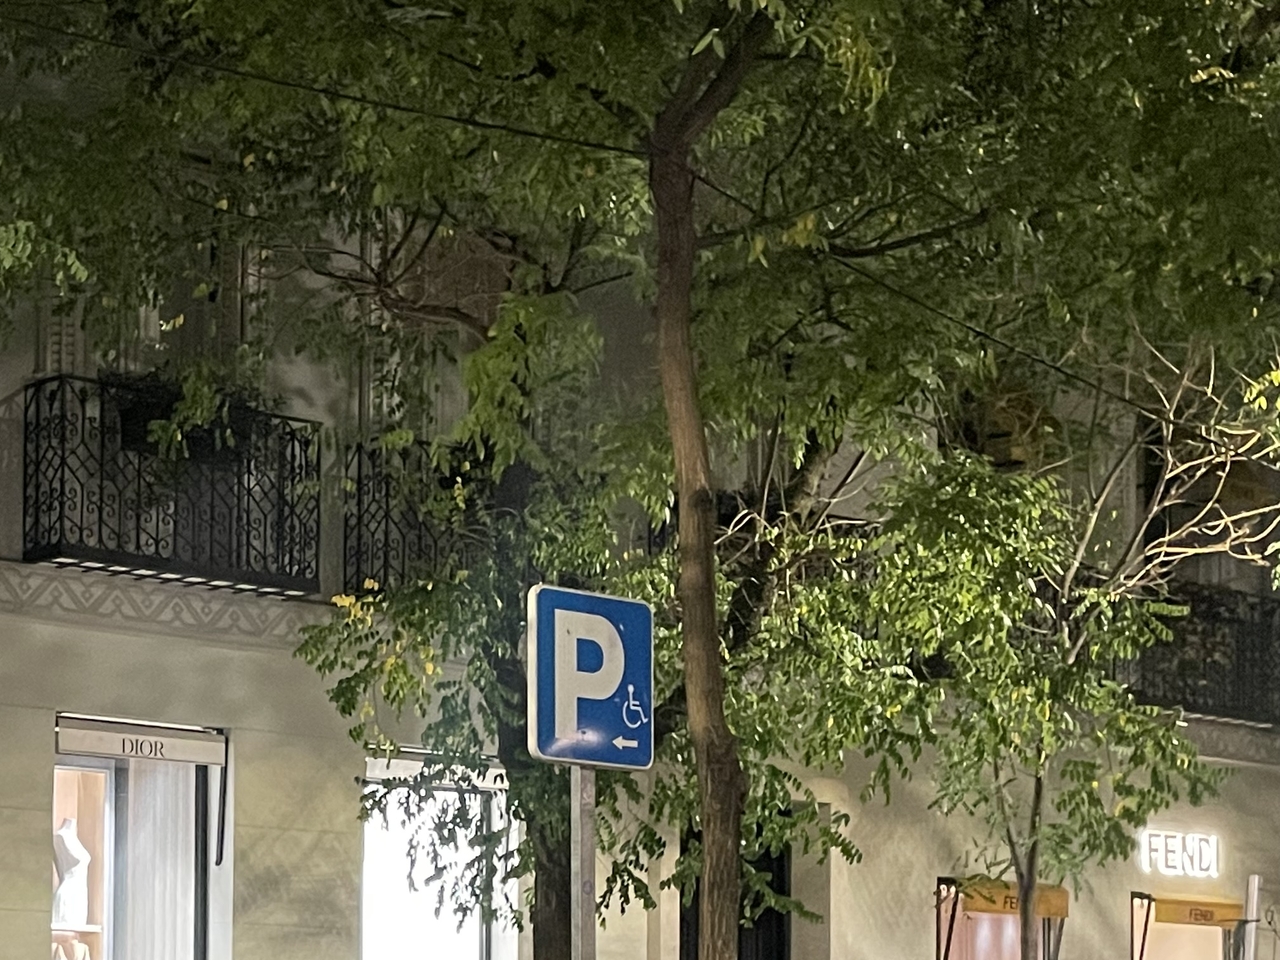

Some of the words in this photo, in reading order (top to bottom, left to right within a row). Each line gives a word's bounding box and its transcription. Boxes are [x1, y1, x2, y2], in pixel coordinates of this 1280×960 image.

[554, 608, 625, 739] P
[122, 738, 165, 758] DIOR
[1144, 831, 1219, 876] FENDI
